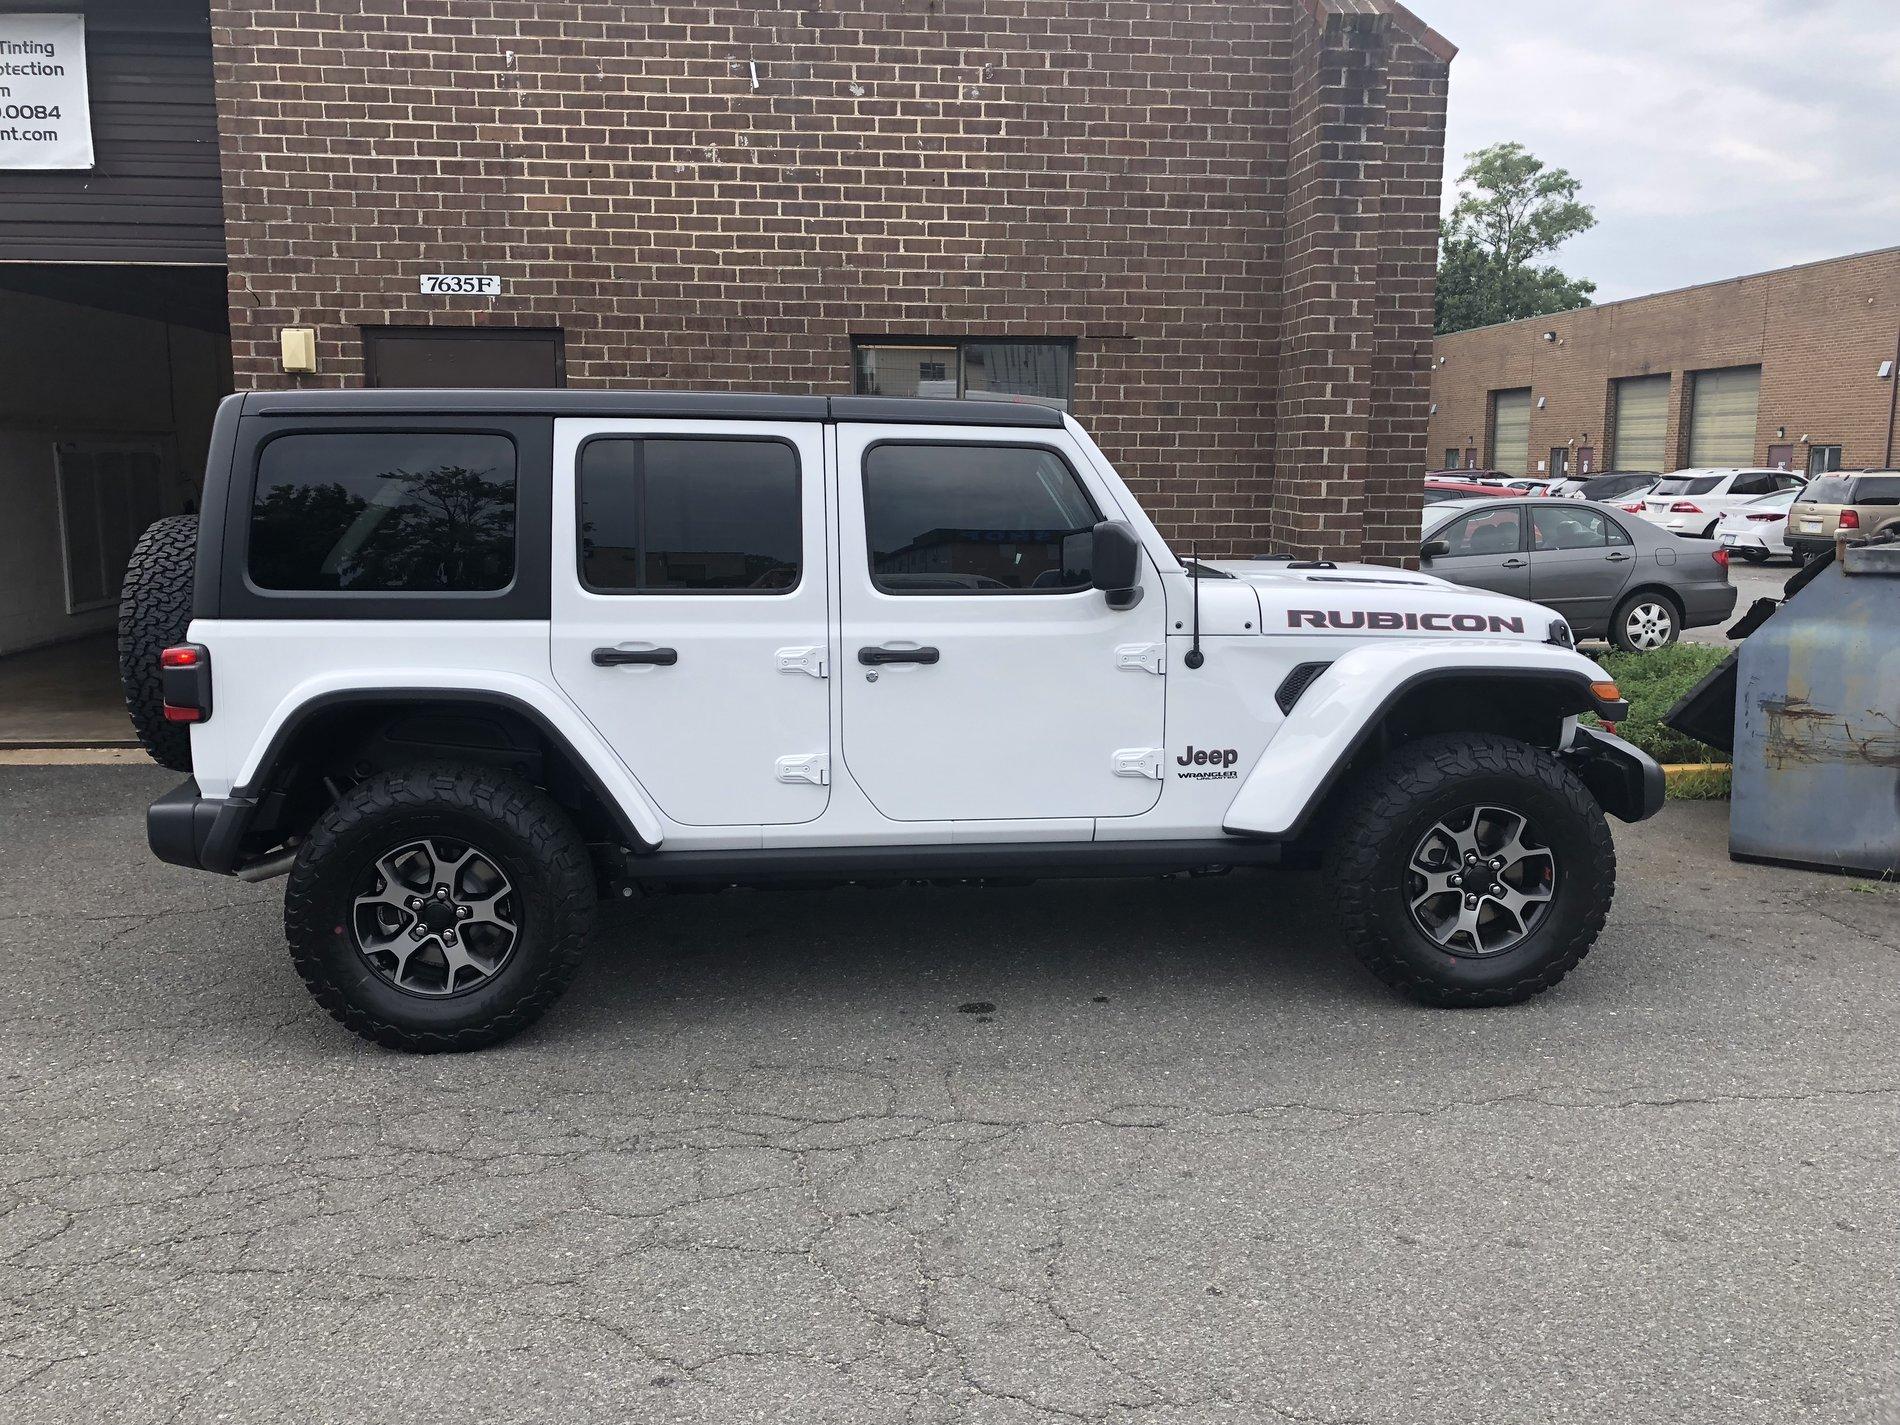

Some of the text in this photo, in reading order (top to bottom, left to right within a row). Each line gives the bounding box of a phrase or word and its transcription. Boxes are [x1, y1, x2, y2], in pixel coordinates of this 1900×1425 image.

[0, 41, 55, 57] Tinting
[0, 105, 61, 120] .0084
[0, 127, 58, 141] nt.com
[427, 277, 493, 292] 7635F
[1287, 609, 1524, 633] RUBICON
[1177, 745, 1238, 768] Jeep
